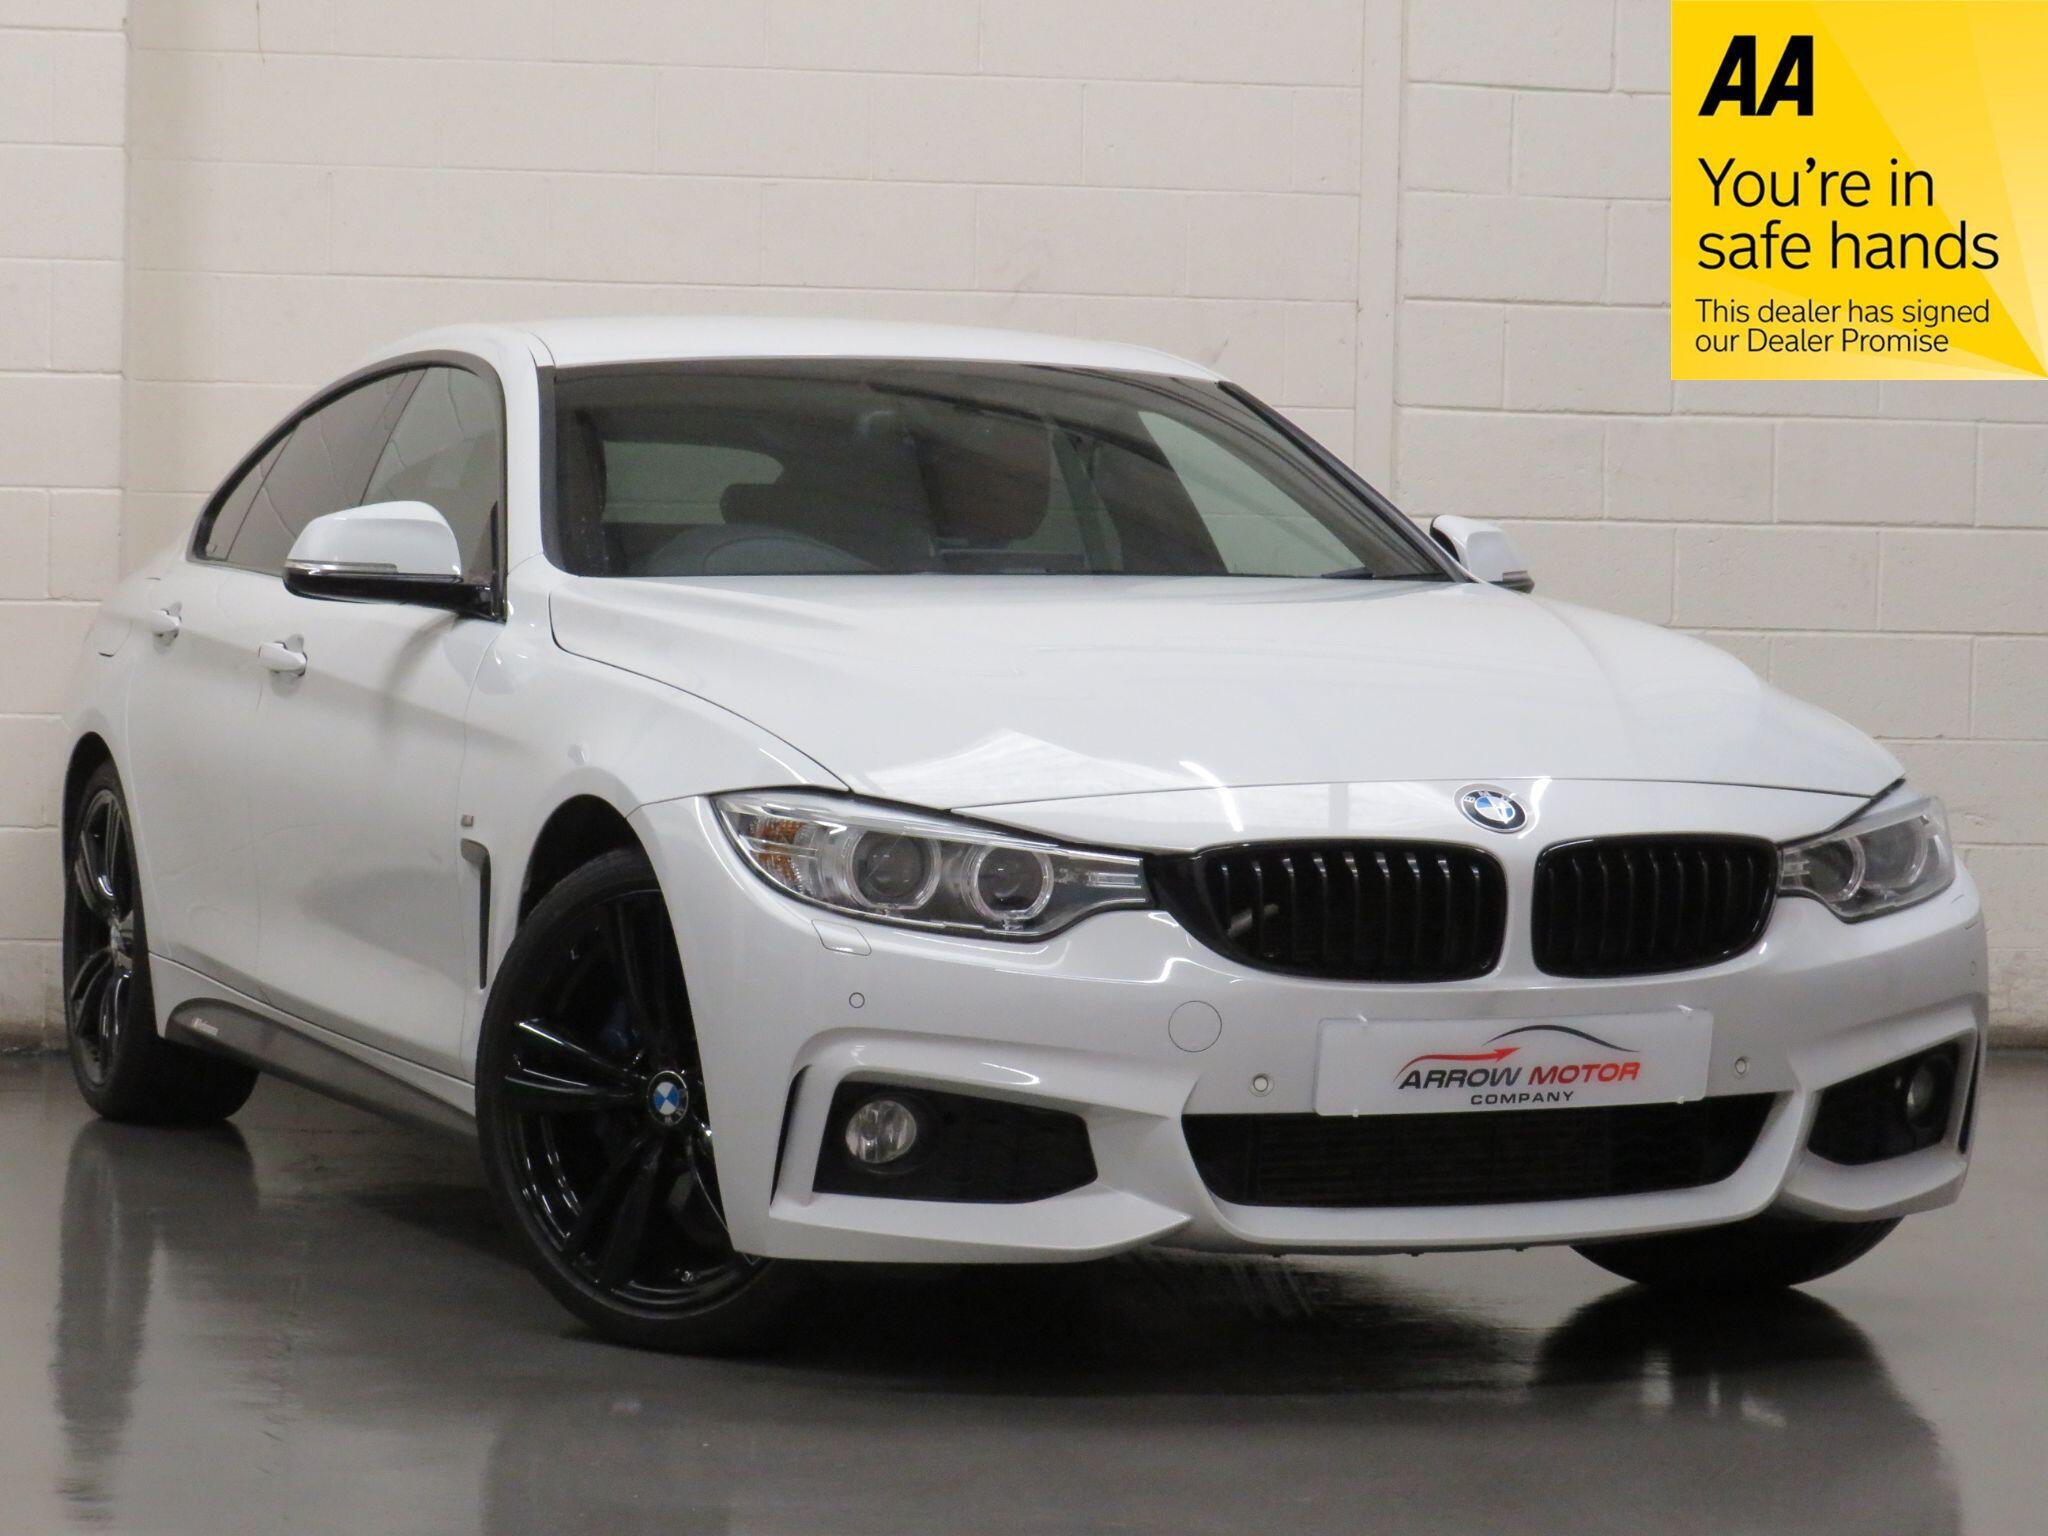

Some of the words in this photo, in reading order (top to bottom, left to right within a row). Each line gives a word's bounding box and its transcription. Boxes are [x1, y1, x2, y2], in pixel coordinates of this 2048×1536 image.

[1398, 1067, 1522, 1090] ARROW
[1528, 1062, 1641, 1085] MOTOR
[1470, 1091, 1575, 1106] COMPANY
